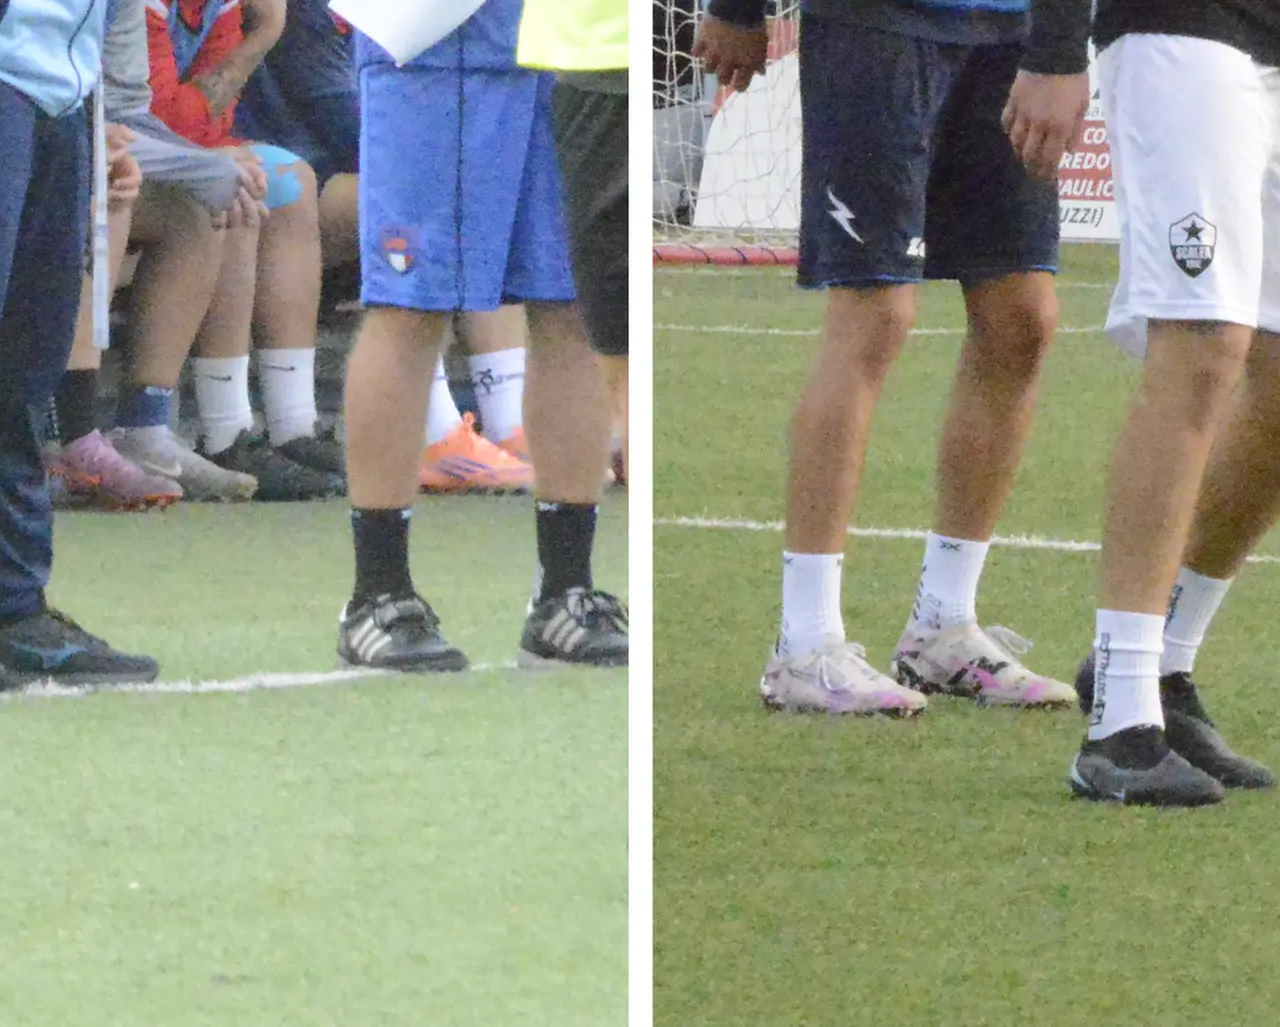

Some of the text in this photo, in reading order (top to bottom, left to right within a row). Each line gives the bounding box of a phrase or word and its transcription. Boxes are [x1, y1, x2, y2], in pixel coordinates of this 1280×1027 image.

[1059, 151, 1111, 171] REDO
[1059, 177, 1115, 198] AULIC
[1060, 205, 1104, 228] UZZI)
